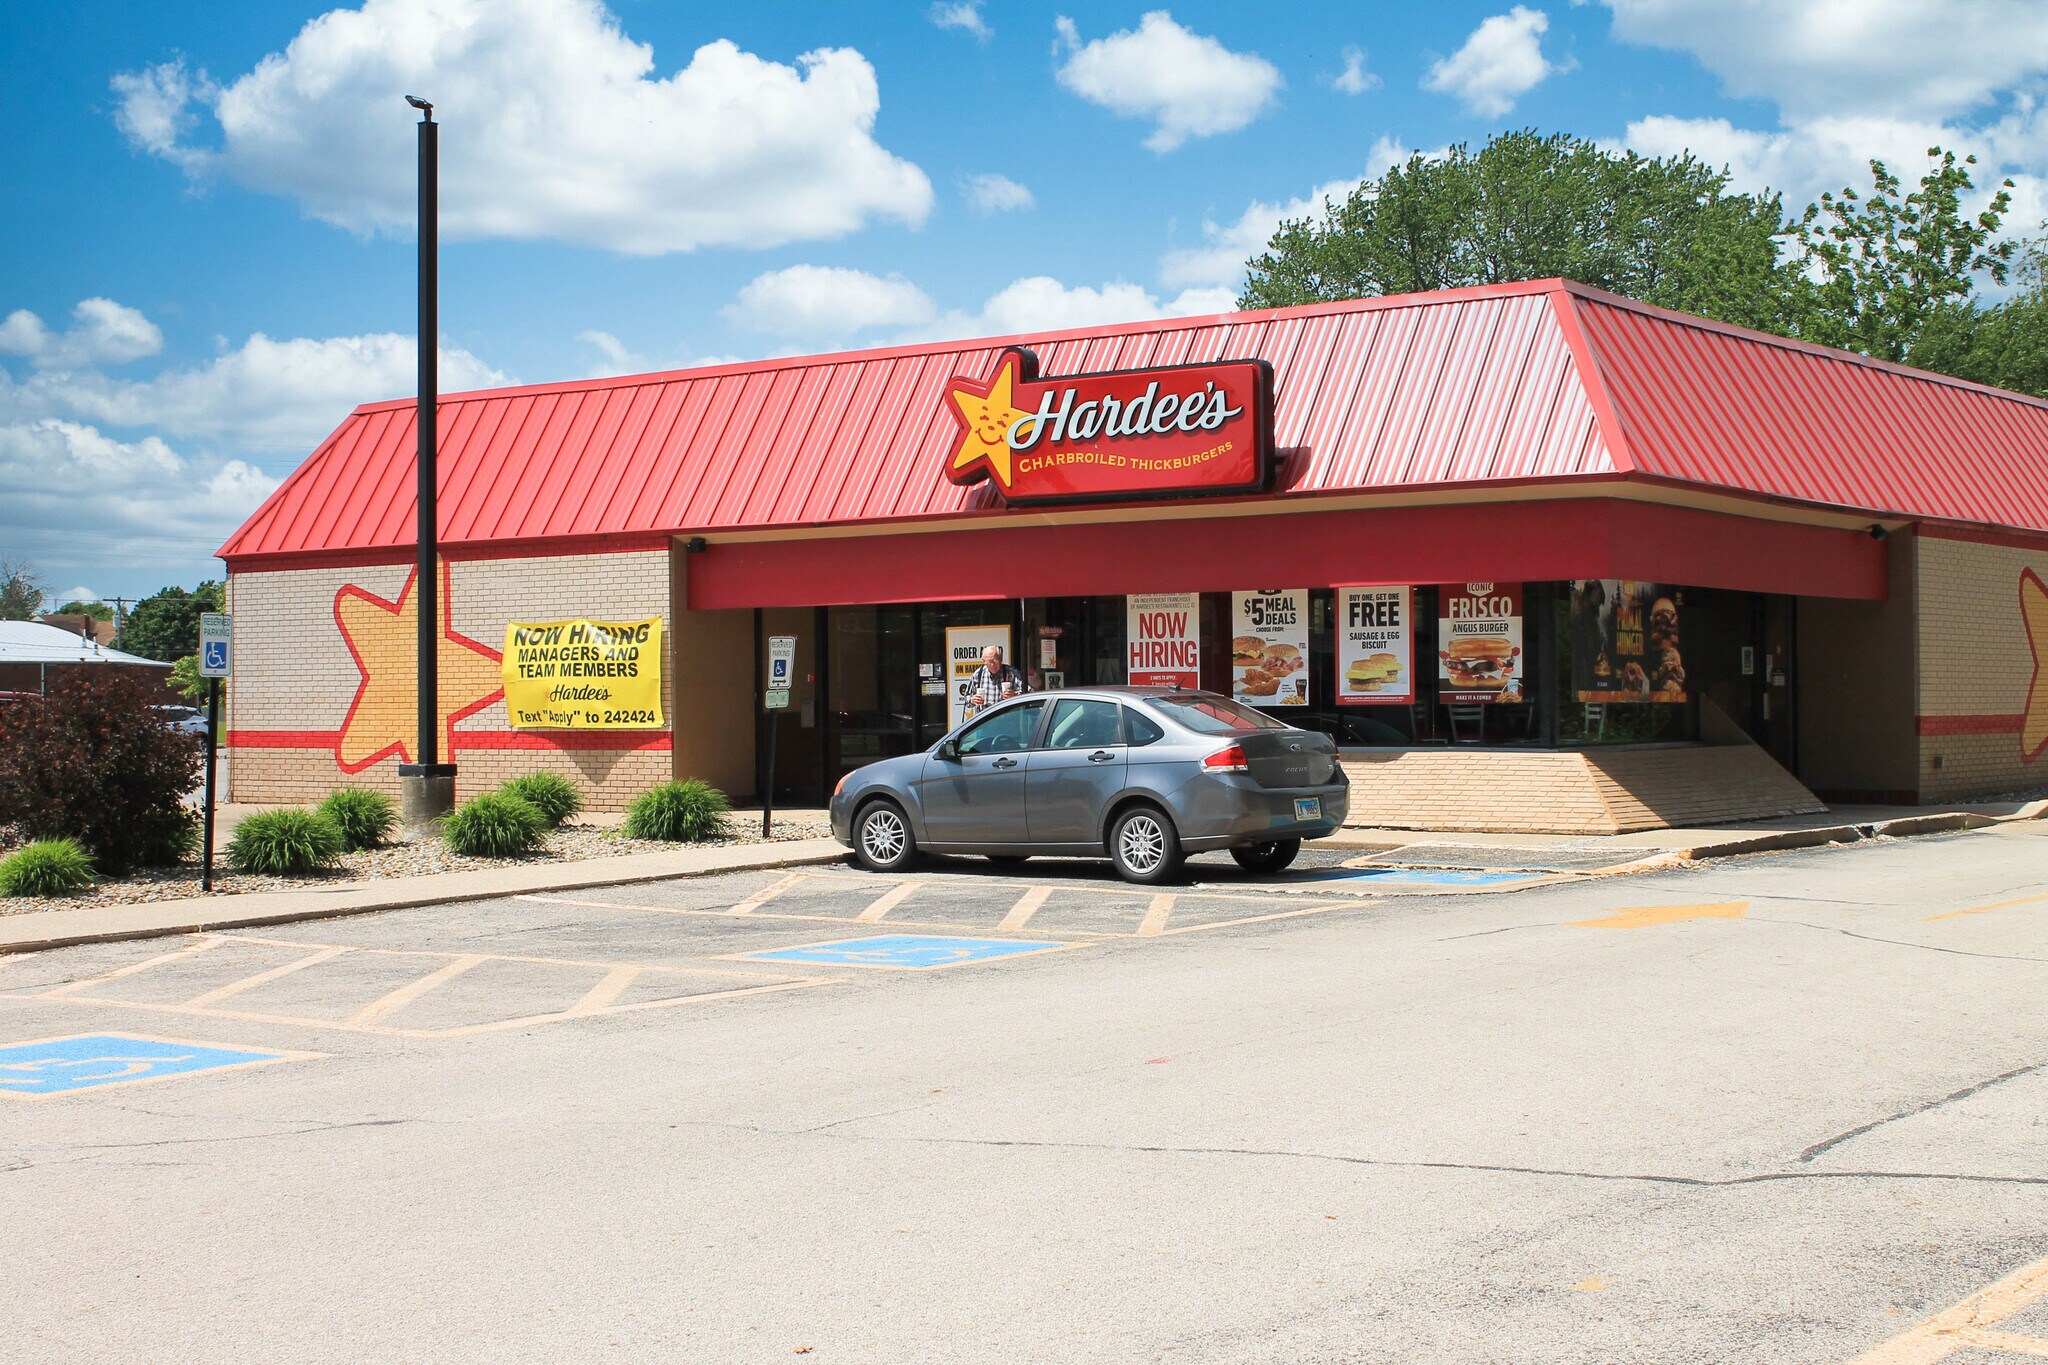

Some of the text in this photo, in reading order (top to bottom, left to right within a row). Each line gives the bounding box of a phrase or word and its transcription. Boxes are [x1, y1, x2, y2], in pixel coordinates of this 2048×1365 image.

[1006, 381, 1243, 450] Hardee's
[1019, 441, 1233, 473] CHARBROILED THICKBURGERS
[1468, 582, 1492, 591] ICONIC
[1244, 597, 1296, 625] $5 MEAL
[1349, 601, 1400, 627] FREE
[1449, 596, 1512, 619] FRISCO
[203, 617, 231, 626] RESERVED
[1139, 612, 1187, 639] NOW
[1266, 613, 1296, 625] DEALS
[203, 628, 230, 637] PARKING
[514, 623, 650, 646] NOW HIRING
[1349, 632, 1379, 640] SAUSAGE
[1381, 632, 1385, 640] &
[1452, 623, 1509, 633] ANGUS BURGER
[954, 647, 978, 659] ORDER
[1362, 641, 1387, 649] BISCUIT
[518, 647, 639, 663] MANAGERS AND
[1130, 641, 1197, 668] HIRING
[519, 663, 639, 678] TEAM MEMBERS
[956, 665, 964, 673] ON
[550, 684, 612, 702] Hardee's
[518, 710, 655, 726] Text "Apply" to 242424
